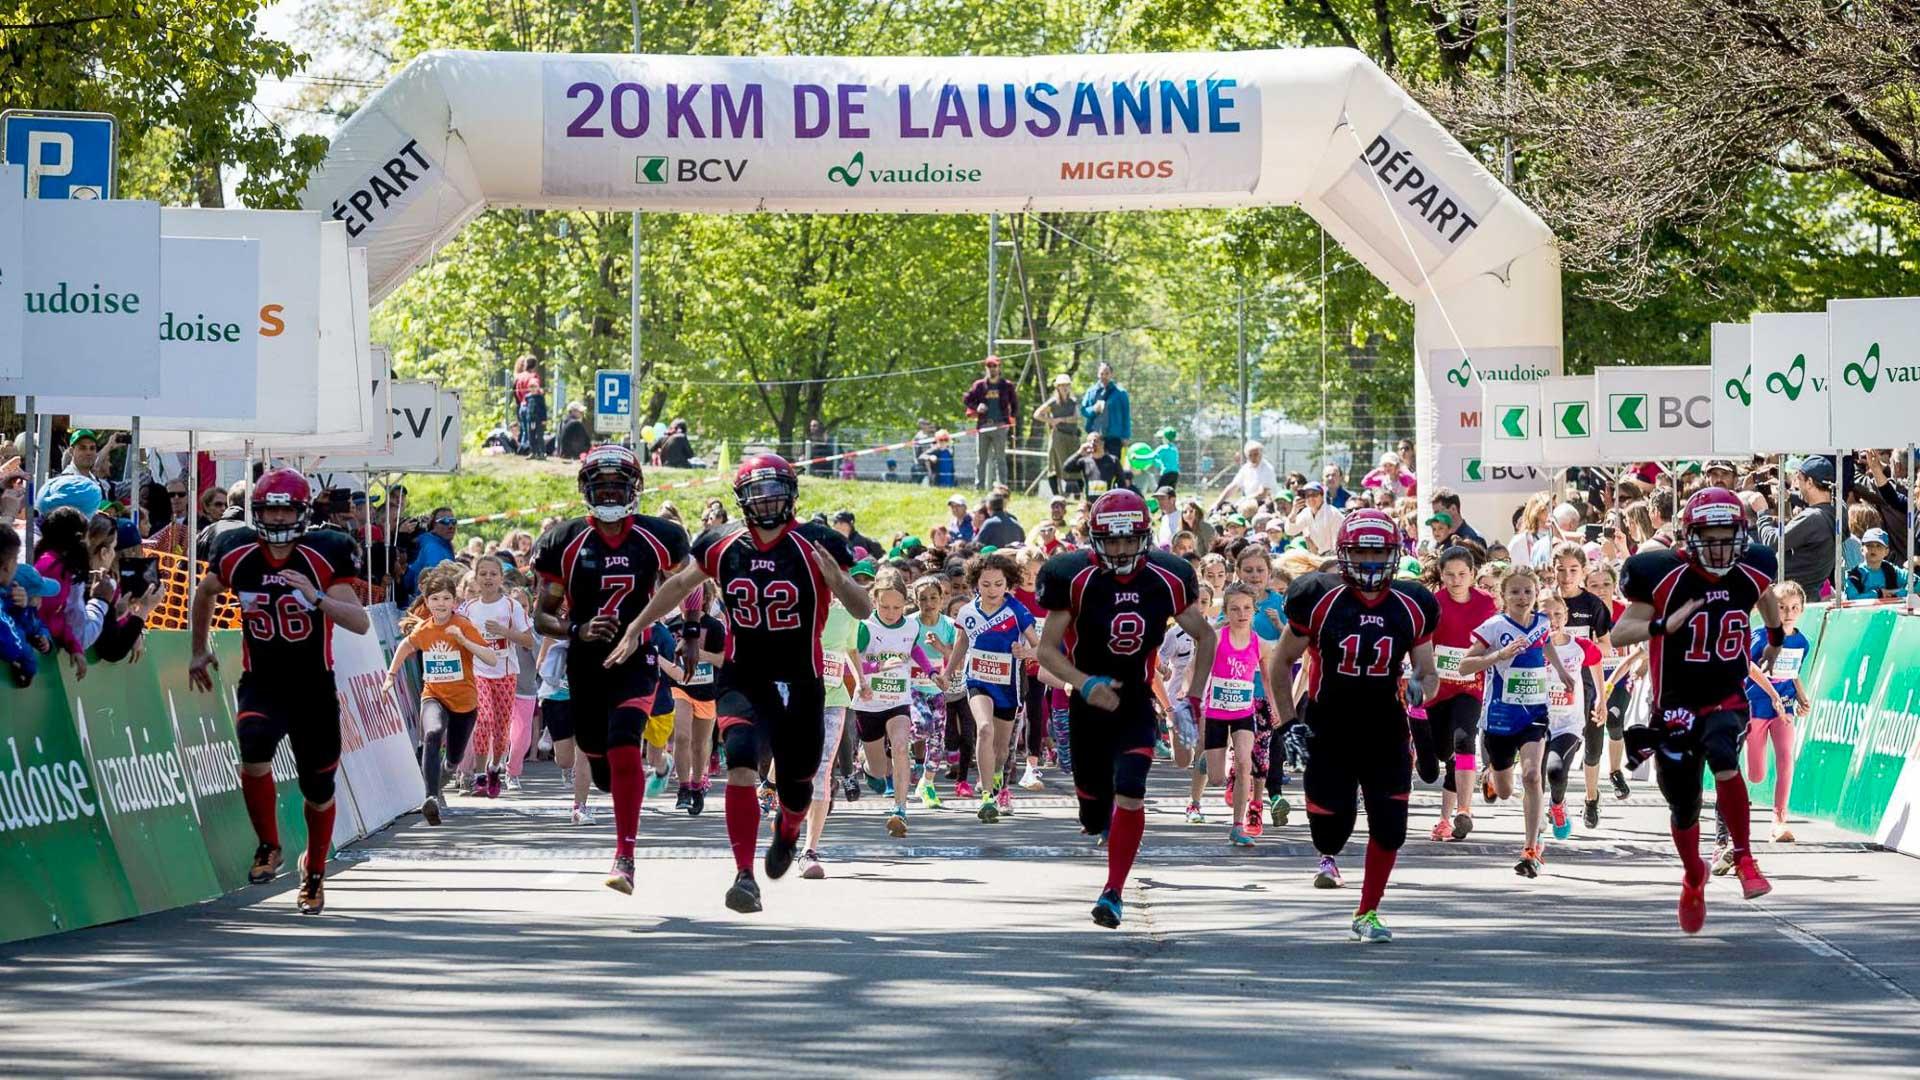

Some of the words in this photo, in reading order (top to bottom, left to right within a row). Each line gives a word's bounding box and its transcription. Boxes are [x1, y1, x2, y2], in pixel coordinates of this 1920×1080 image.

[566, 82, 651, 139] 20
[666, 83, 764, 139] KM
[793, 83, 871, 139] DE
[898, 79, 1241, 139] LAUSANNE
[27, 131, 74, 200] P
[677, 159, 748, 182] BCV
[869, 163, 982, 183] vaudoise
[1060, 160, 1174, 180] MIGROS
[1359, 134, 1478, 244] DÉPART
[24, 282, 140, 314] udoise
[159, 312, 241, 342] doise
[258, 304, 286, 337] S
[1476, 364, 1551, 381] vaudoise
[1811, 376, 1828, 393] v
[604, 378, 620, 407] P
[1658, 396, 1712, 429] BC
[604, 556, 630, 568] LUC
[750, 559, 776, 572] LUC
[261, 574, 289, 587] LUC
[597, 574, 635, 620] 7
[726, 578, 800, 631] 32
[1114, 592, 1140, 605] LUC
[1705, 590, 1730, 604] LUC
[243, 592, 313, 642] 56
[1360, 615, 1384, 627] LUC
[1107, 612, 1145, 656] 8
[1685, 609, 1749, 662] 16
[430, 666, 455, 674] 35162
[976, 665, 1002, 675] 35146
[1337, 634, 1393, 677] 11
[876, 684, 901, 692] 35046
[1219, 693, 1245, 702] 35105
[96, 725, 186, 815] vaudoise
[185, 717, 243, 799] vaudoise
